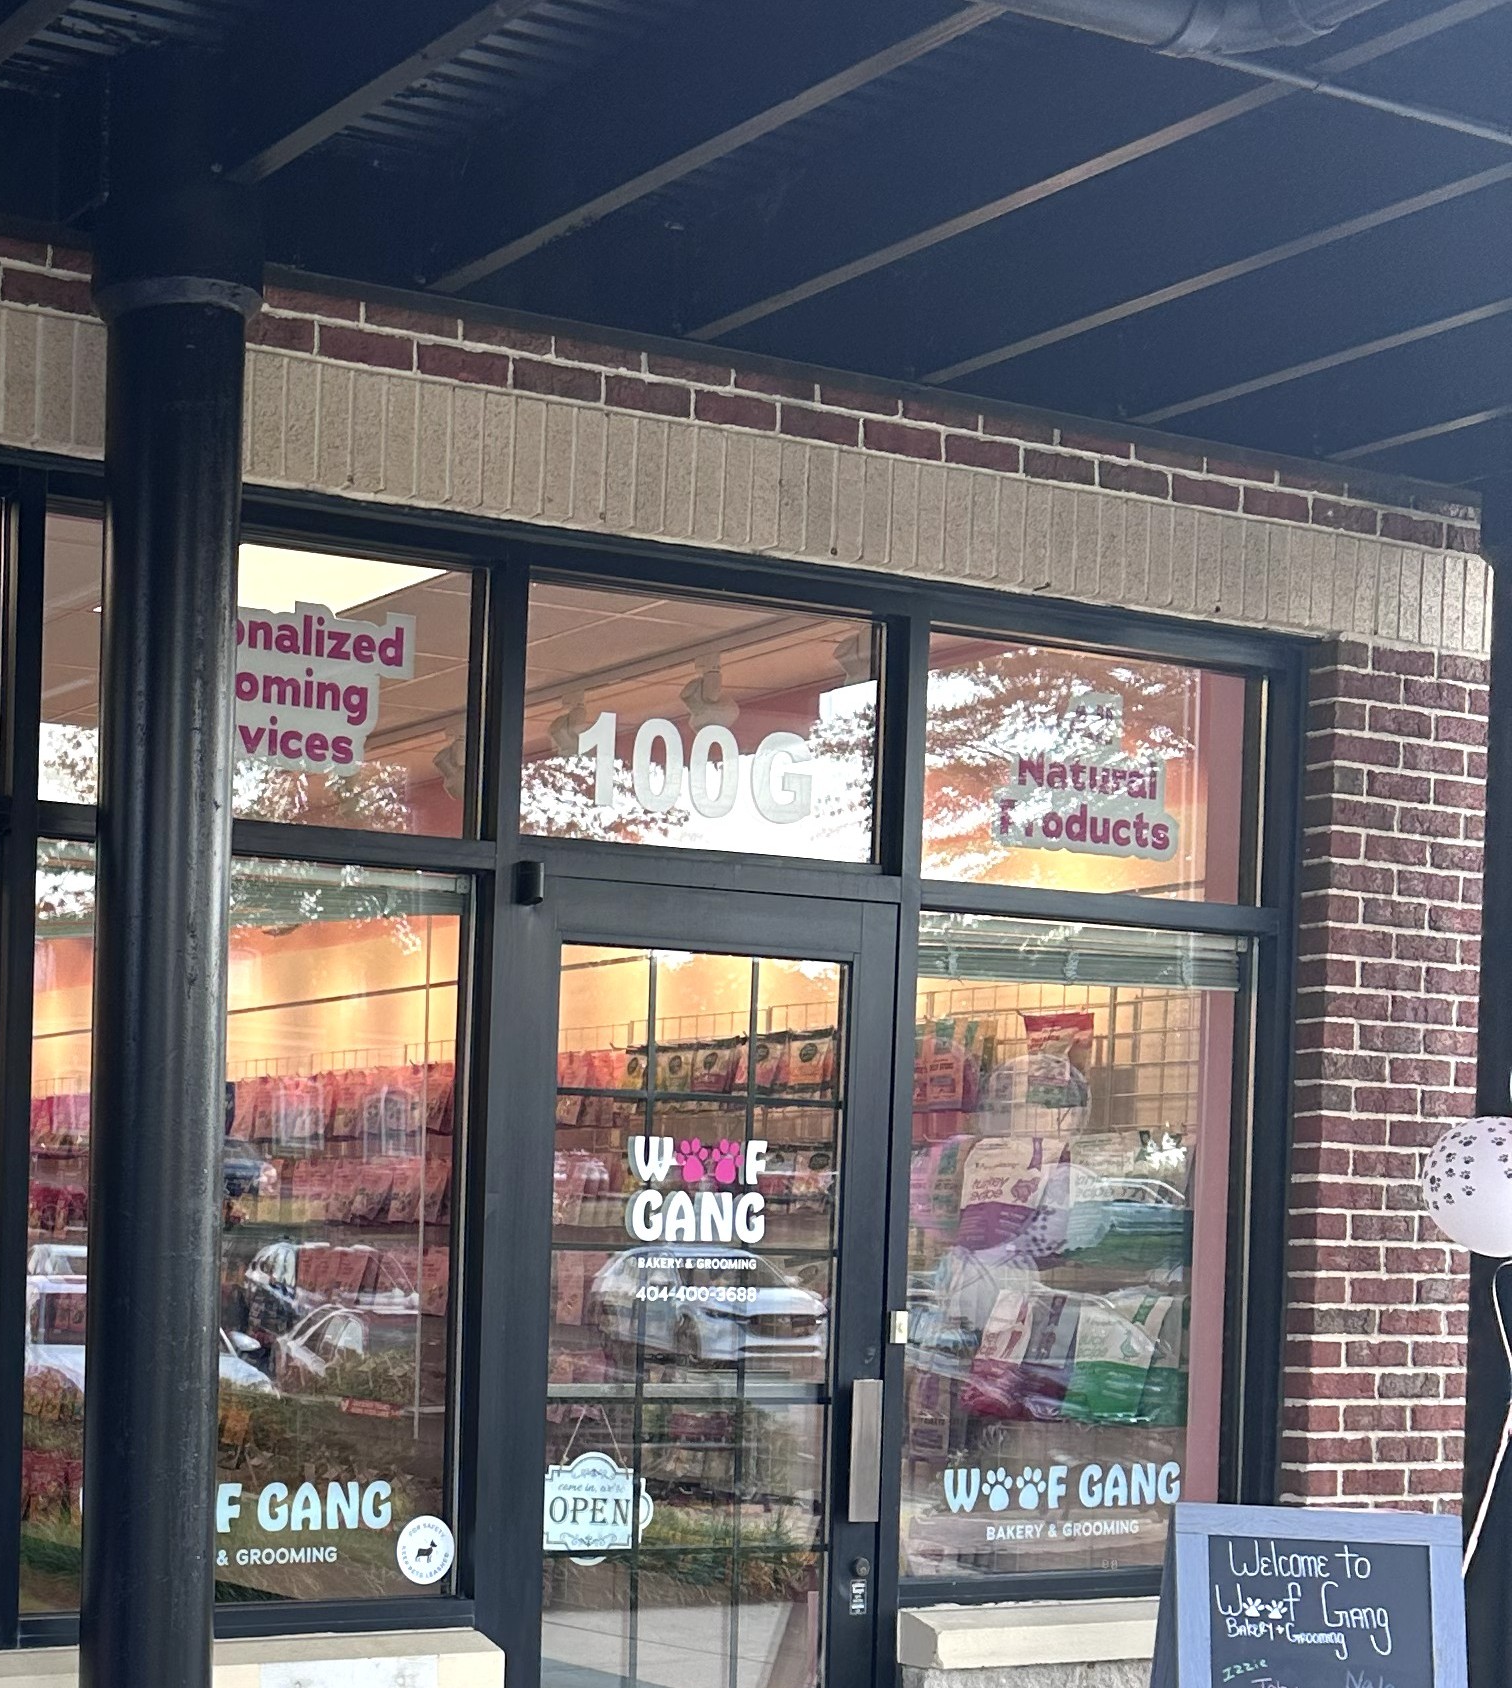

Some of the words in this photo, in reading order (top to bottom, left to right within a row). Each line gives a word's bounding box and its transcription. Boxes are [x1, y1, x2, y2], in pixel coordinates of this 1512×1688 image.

[235, 667, 369, 726] oming
[238, 715, 354, 765] vices
[577, 711, 814, 825] 100G
[1017, 752, 1158, 800] Natural
[632, 1189, 766, 1244] GANG
[637, 1257, 683, 1270] BAKERY
[685, 1258, 695, 1270] &
[696, 1258, 757, 1270] GROOMING
[635, 1286, 757, 1302] 404-400-3688
[257, 1480, 392, 1532] GANG
[1078, 1461, 1182, 1508] GANG
[549, 1496, 630, 1526] OPEN
[986, 1522, 1044, 1541] BAKERY
[1047, 1522, 1057, 1538] &
[1062, 1519, 1140, 1537] GROOMING
[216, 1549, 228, 1567] &
[236, 1546, 338, 1566] GROOMING
[1228, 1540, 1331, 1578] Welcome
[1334, 1544, 1371, 1579] to
